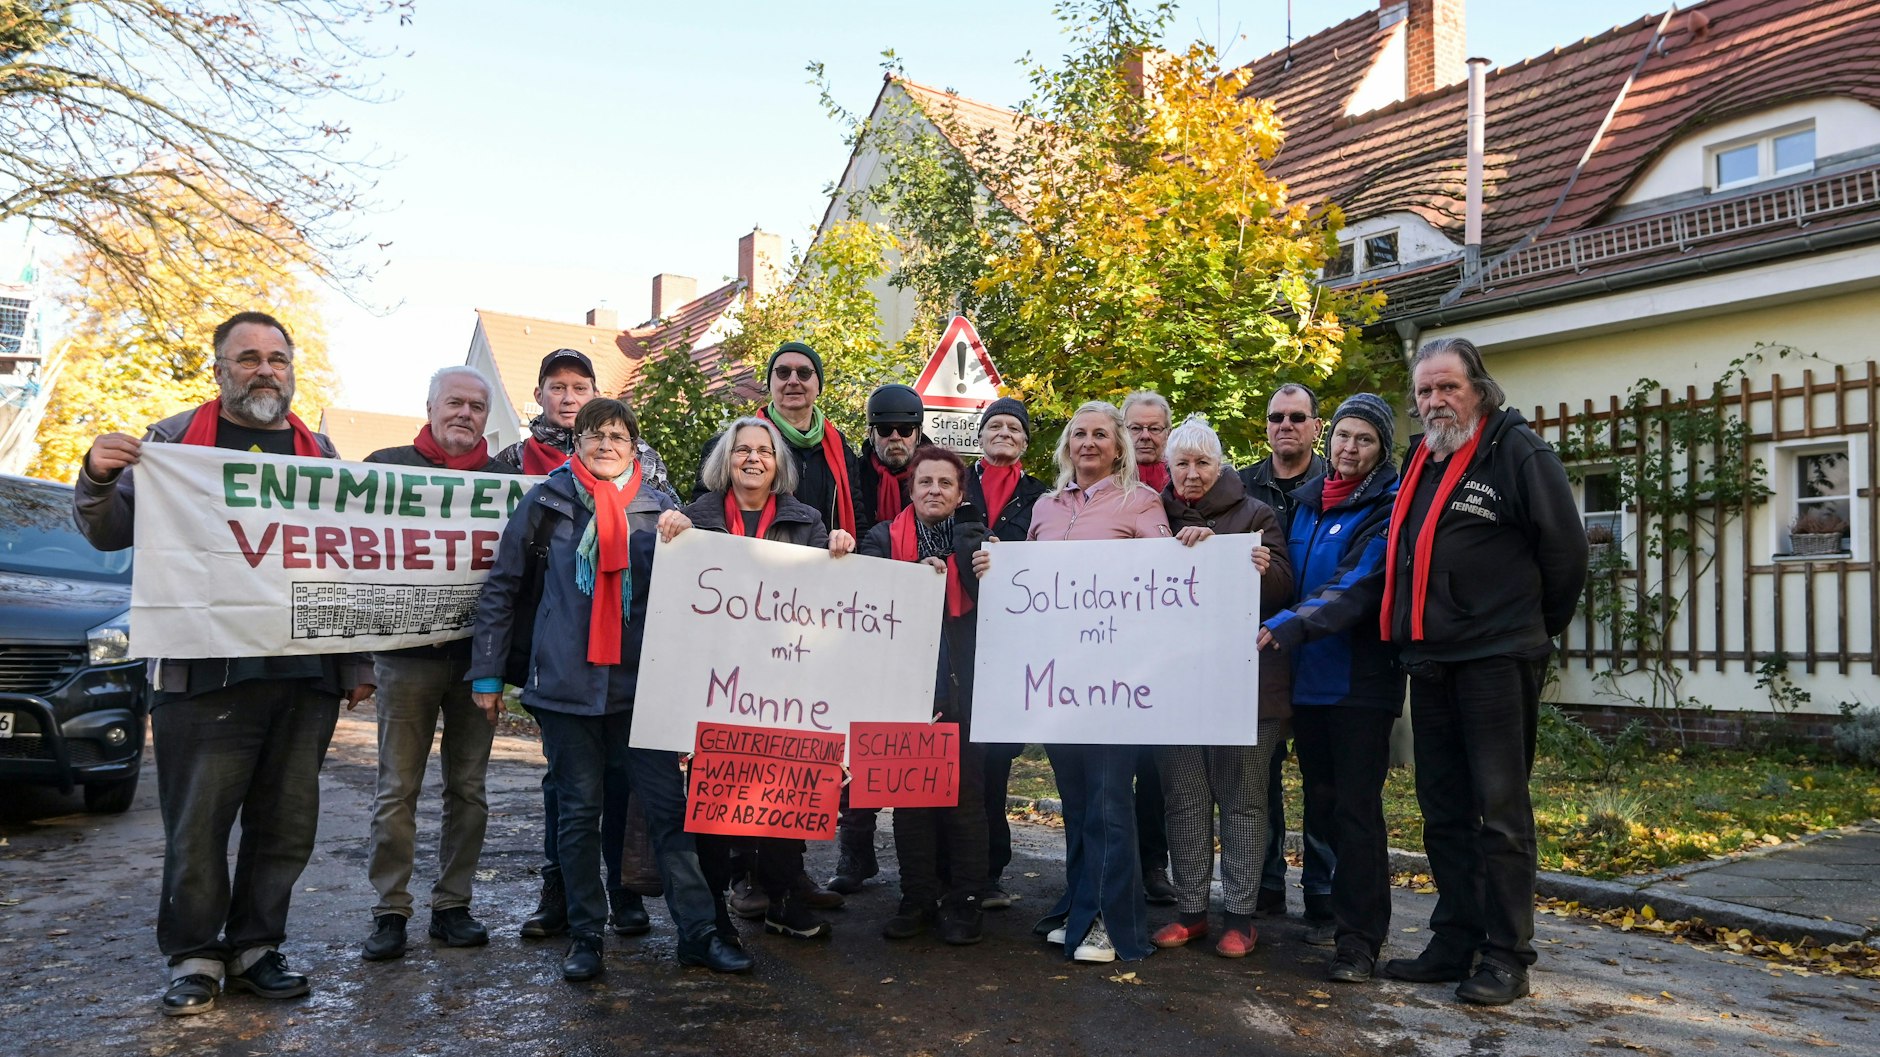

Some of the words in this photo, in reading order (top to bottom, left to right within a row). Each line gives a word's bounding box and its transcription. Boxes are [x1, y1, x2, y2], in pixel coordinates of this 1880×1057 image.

[1465, 494, 1483, 506] AM
[691, 568, 902, 640] Solidarität
[1006, 566, 1200, 614] Solidarität
[1080, 616, 1117, 643] mit
[772, 635, 811, 662] mit
[706, 666, 833, 730] Manne
[1025, 658, 1153, 711] Manne
[700, 728, 845, 762] GENTRIFIZIERUNG
[857, 732, 954, 757] SCHÄMT
[705, 759, 821, 790] WAHNSINN
[867, 762, 954, 797] EUCH!
[697, 781, 750, 800] ROTE
[761, 787, 822, 809] KARTE
[692, 801, 728, 822] FÜR
[731, 804, 830, 832] ABZOCKER
